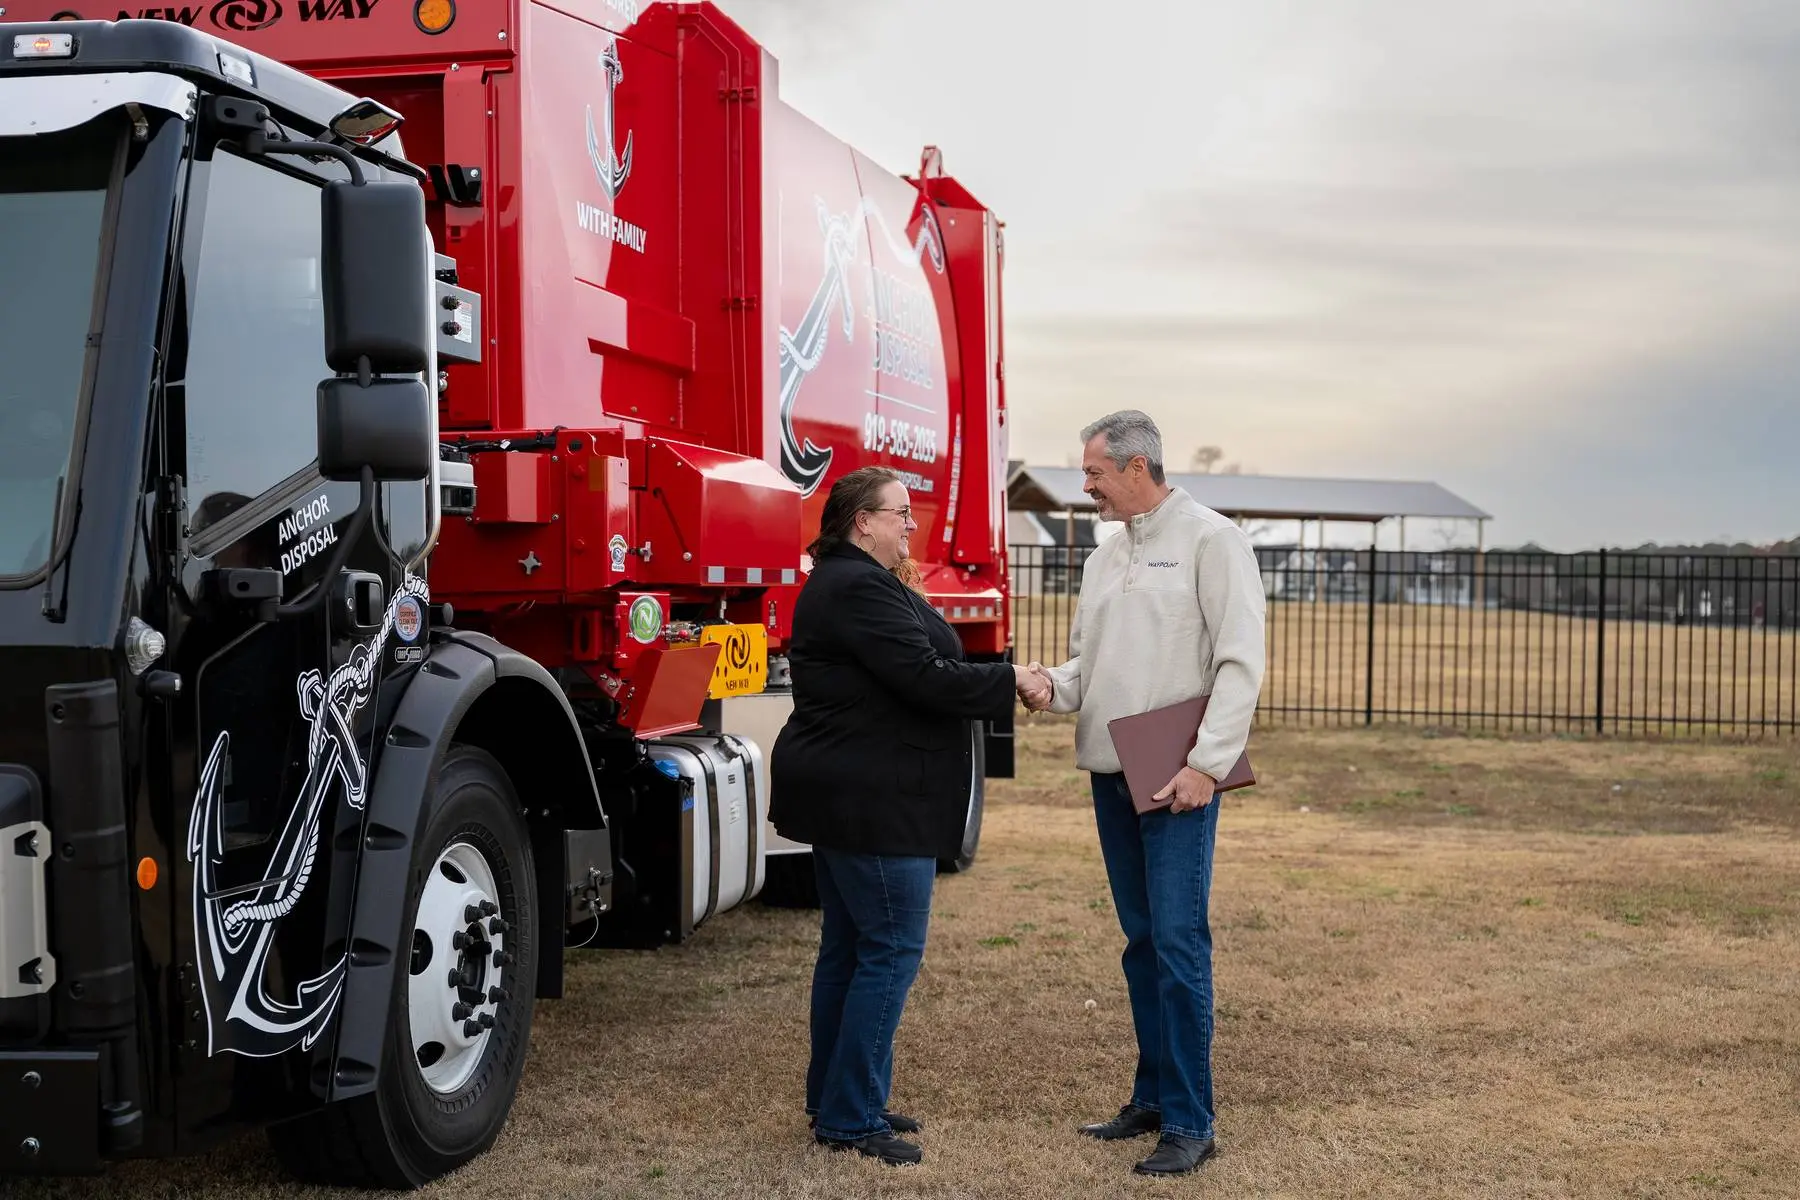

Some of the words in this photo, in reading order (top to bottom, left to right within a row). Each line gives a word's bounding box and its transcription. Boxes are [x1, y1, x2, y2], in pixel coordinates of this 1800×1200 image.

[297, 0, 380, 21] WAY
[576, 200, 610, 238] WITH
[611, 215, 647, 254] FAMILY
[871, 324, 934, 390] DISPOSAL
[863, 412, 937, 464] 919-585-2035
[279, 494, 330, 546] ANCHOR
[280, 523, 338, 576] DISPOSAL
